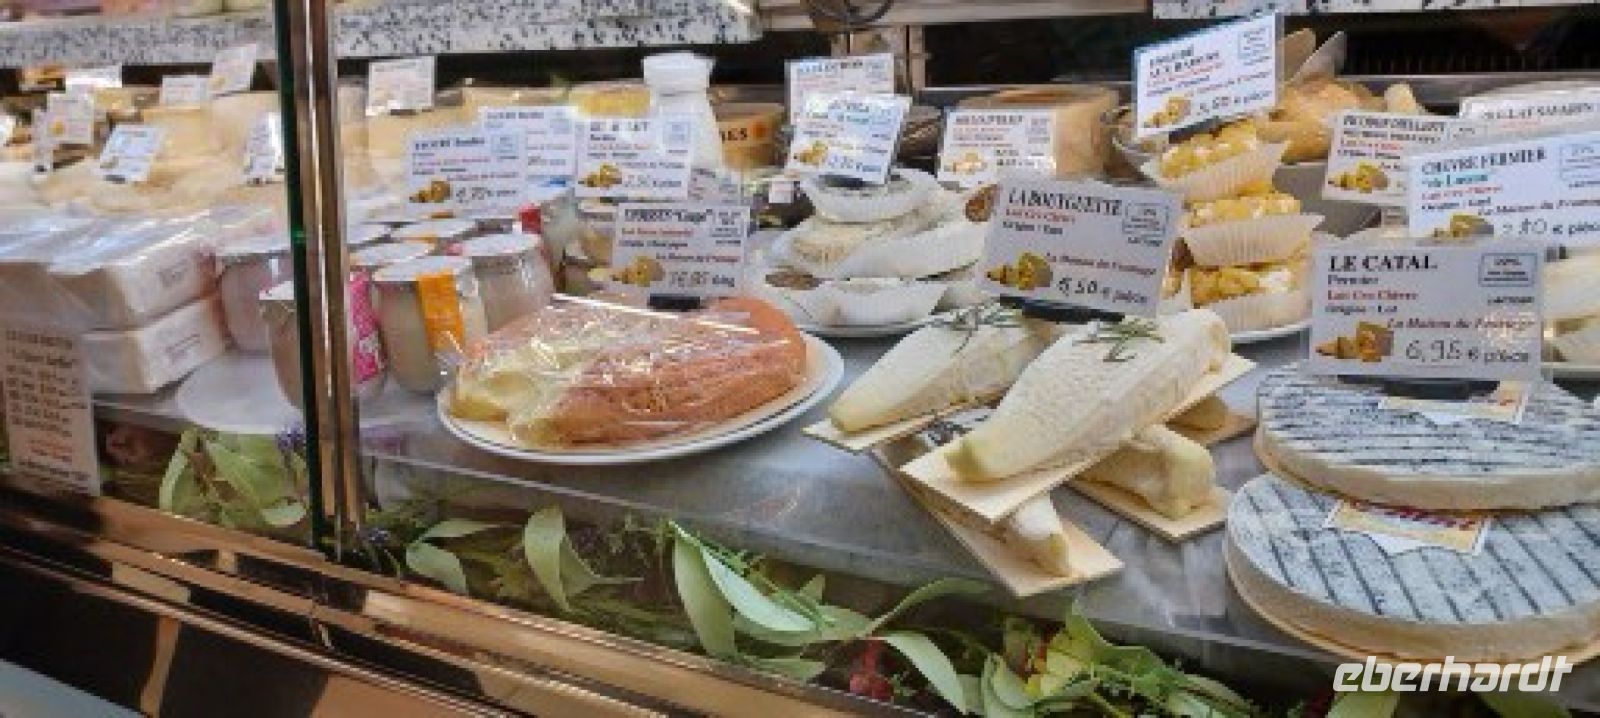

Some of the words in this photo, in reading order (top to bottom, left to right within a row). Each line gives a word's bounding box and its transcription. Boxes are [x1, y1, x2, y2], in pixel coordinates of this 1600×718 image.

[1327, 254, 1358, 273] LE
[1361, 254, 1439, 273] CATAL
[1326, 289, 1351, 301] Lait
[1352, 289, 1376, 301] Cru
[1405, 317, 1451, 330] Maison
[1453, 318, 1473, 330] du
